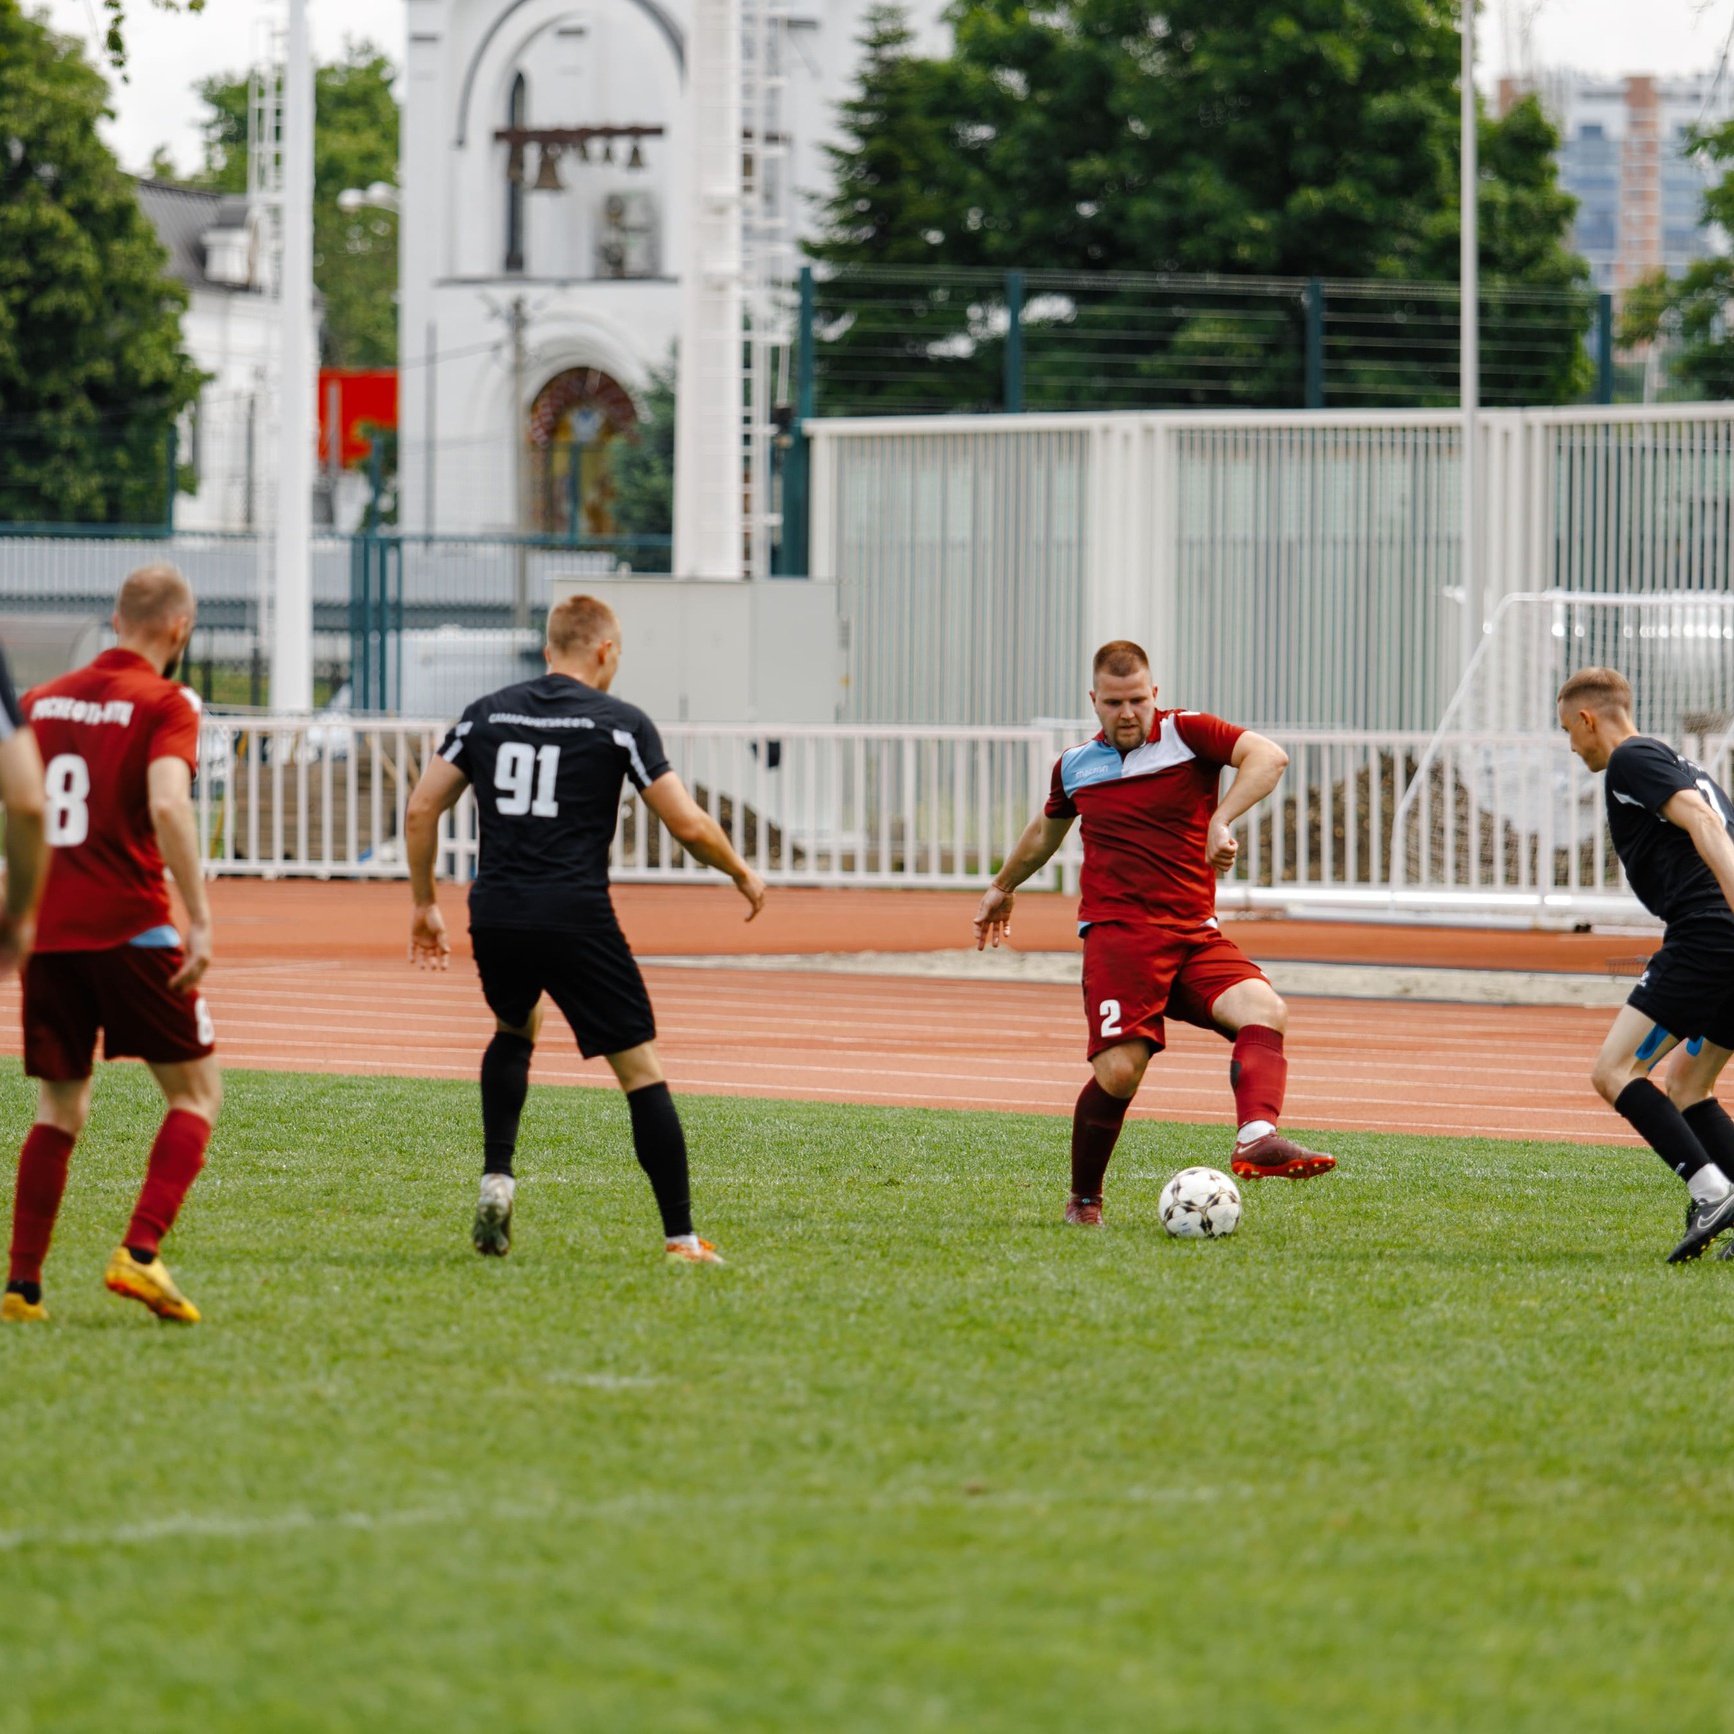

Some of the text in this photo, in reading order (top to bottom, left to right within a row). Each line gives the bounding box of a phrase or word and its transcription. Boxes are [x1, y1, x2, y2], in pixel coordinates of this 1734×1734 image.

[45, 753, 90, 847] 8
[494, 741, 561, 818] 91
[1099, 999, 1122, 1038] 2
